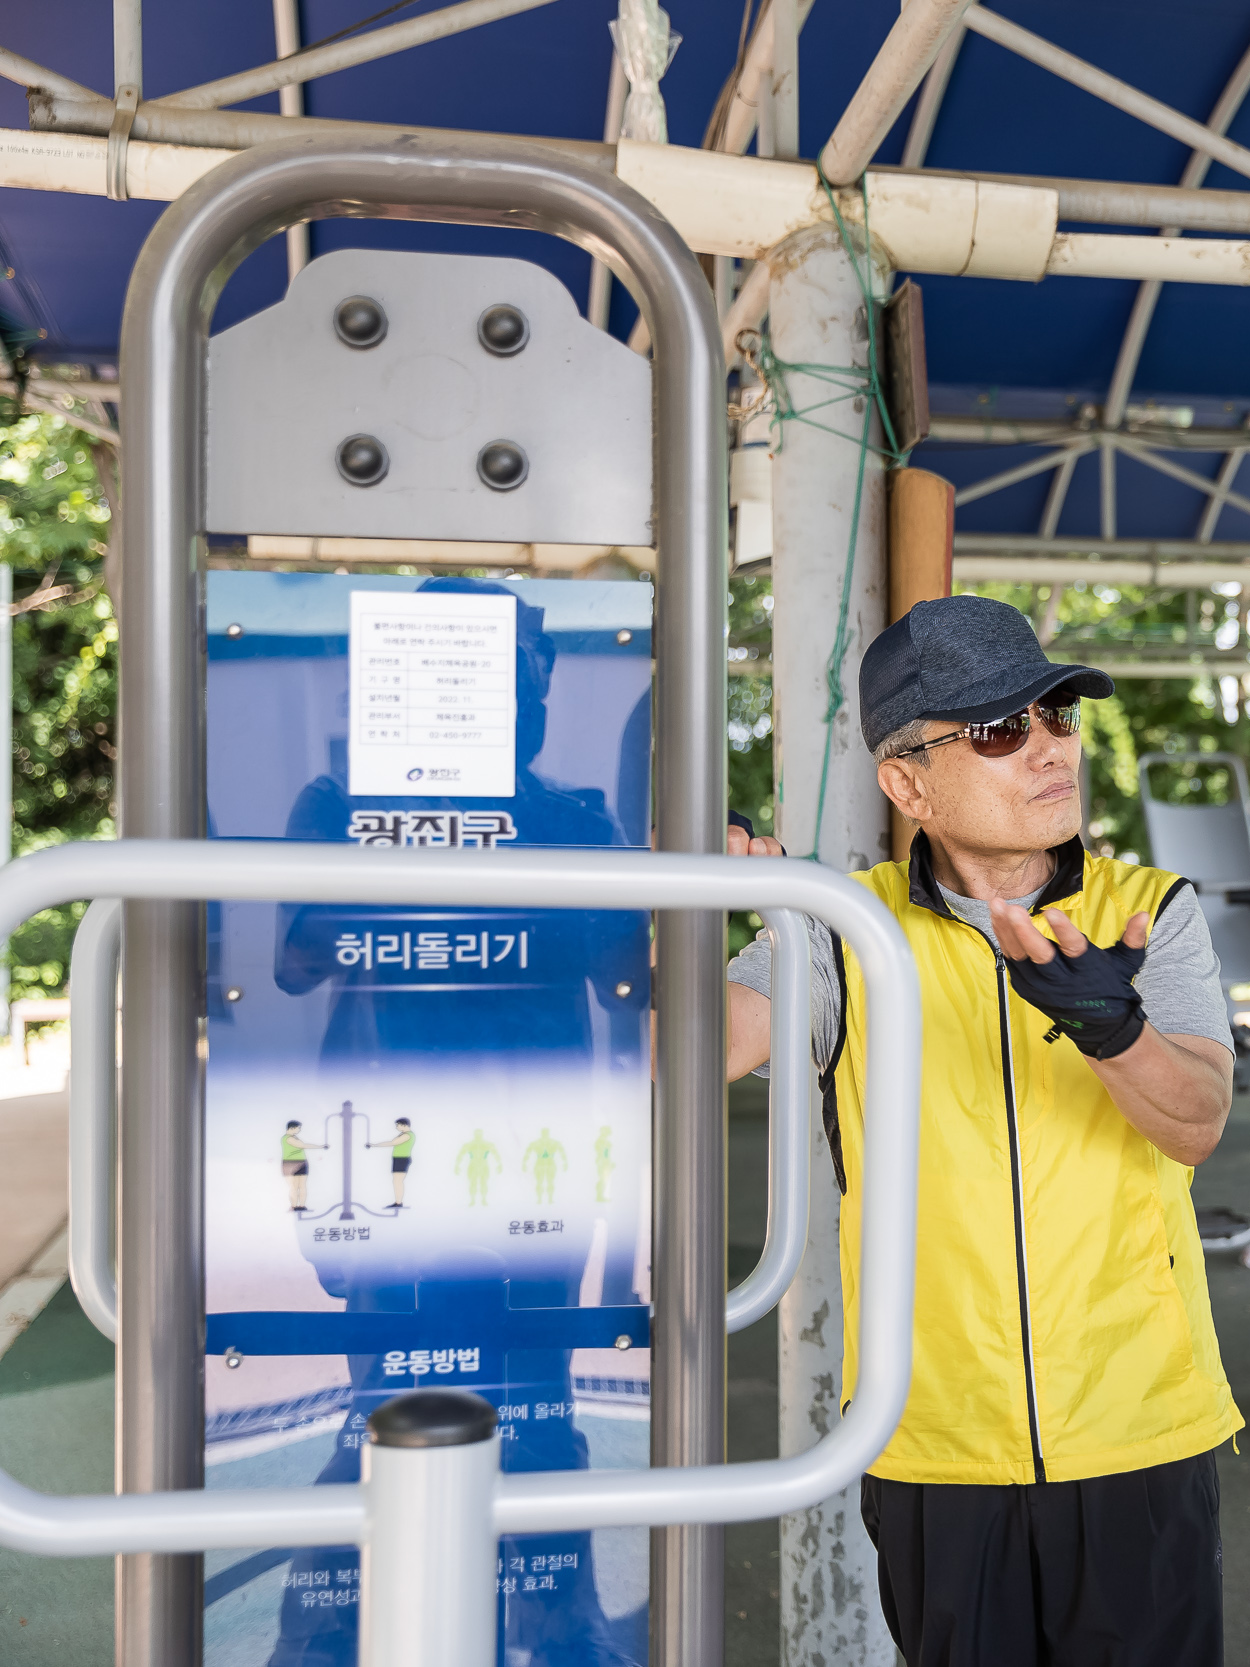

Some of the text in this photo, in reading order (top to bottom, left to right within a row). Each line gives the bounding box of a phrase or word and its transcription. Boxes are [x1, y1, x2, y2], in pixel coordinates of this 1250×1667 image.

[427, 638, 451, 648] 주시기
[368, 657, 401, 666] 관리번호
[435, 677, 477, 687] 허리돌리기
[368, 693, 401, 703] 설치년월
[368, 711, 401, 720] 관리부서
[428, 768, 461, 777] 광진구
[348, 811, 518, 849] 광진구
[335, 931, 529, 971] 허리돌리기
[313, 1226, 371, 1242] 운동방법
[508, 1220, 565, 1235] 운동효과
[382, 1347, 480, 1375] 운동방법
[497, 1403, 529, 1421] 위에
[509, 1556, 525, 1573] 각
[530, 1552, 578, 1572] 관절의
[281, 1570, 330, 1589] 허리와
[522, 1574, 559, 1591] 효과.
